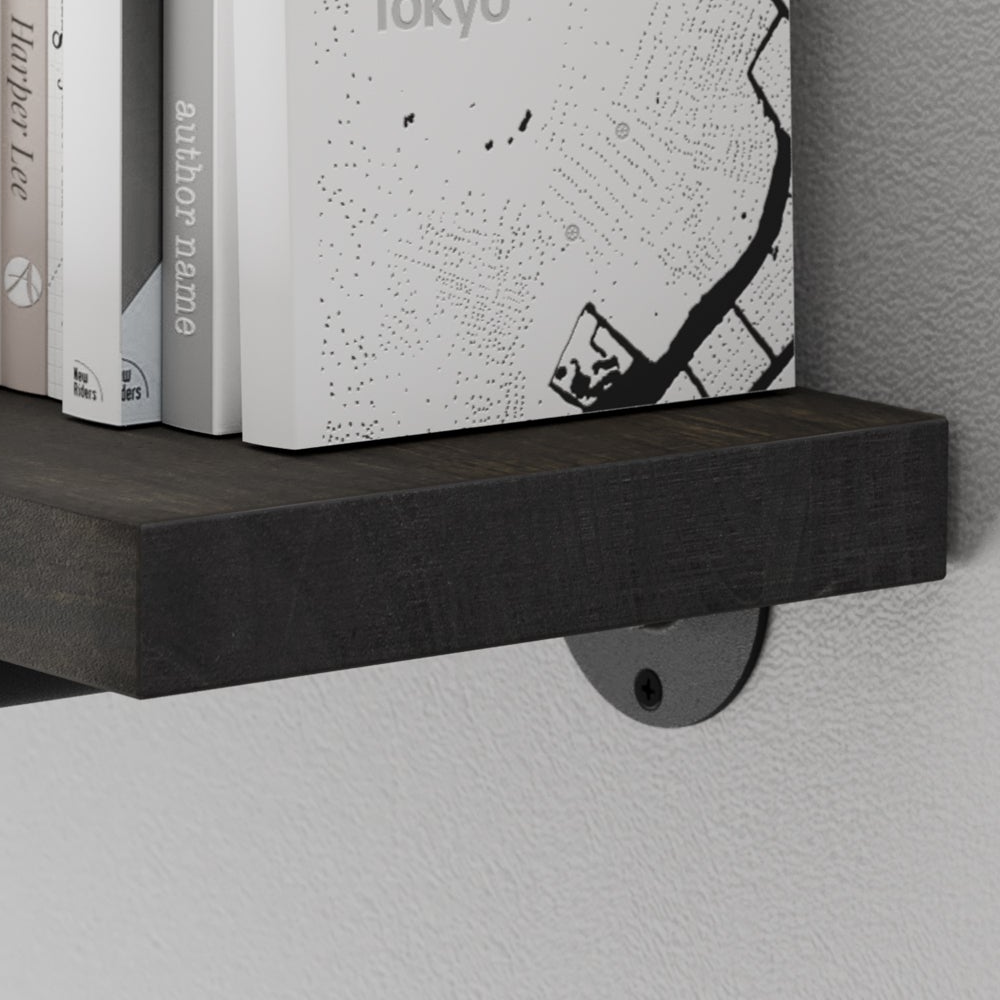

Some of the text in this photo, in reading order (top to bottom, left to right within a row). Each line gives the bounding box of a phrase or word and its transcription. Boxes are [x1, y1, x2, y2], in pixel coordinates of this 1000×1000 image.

[7, 13, 36, 138] Harper
[11, 143, 36, 202] Lee
[175, 99, 202, 336] author name
[73, 367, 90, 386] New
[73, 383, 98, 403] Riders
[121, 386, 143, 402] ders
